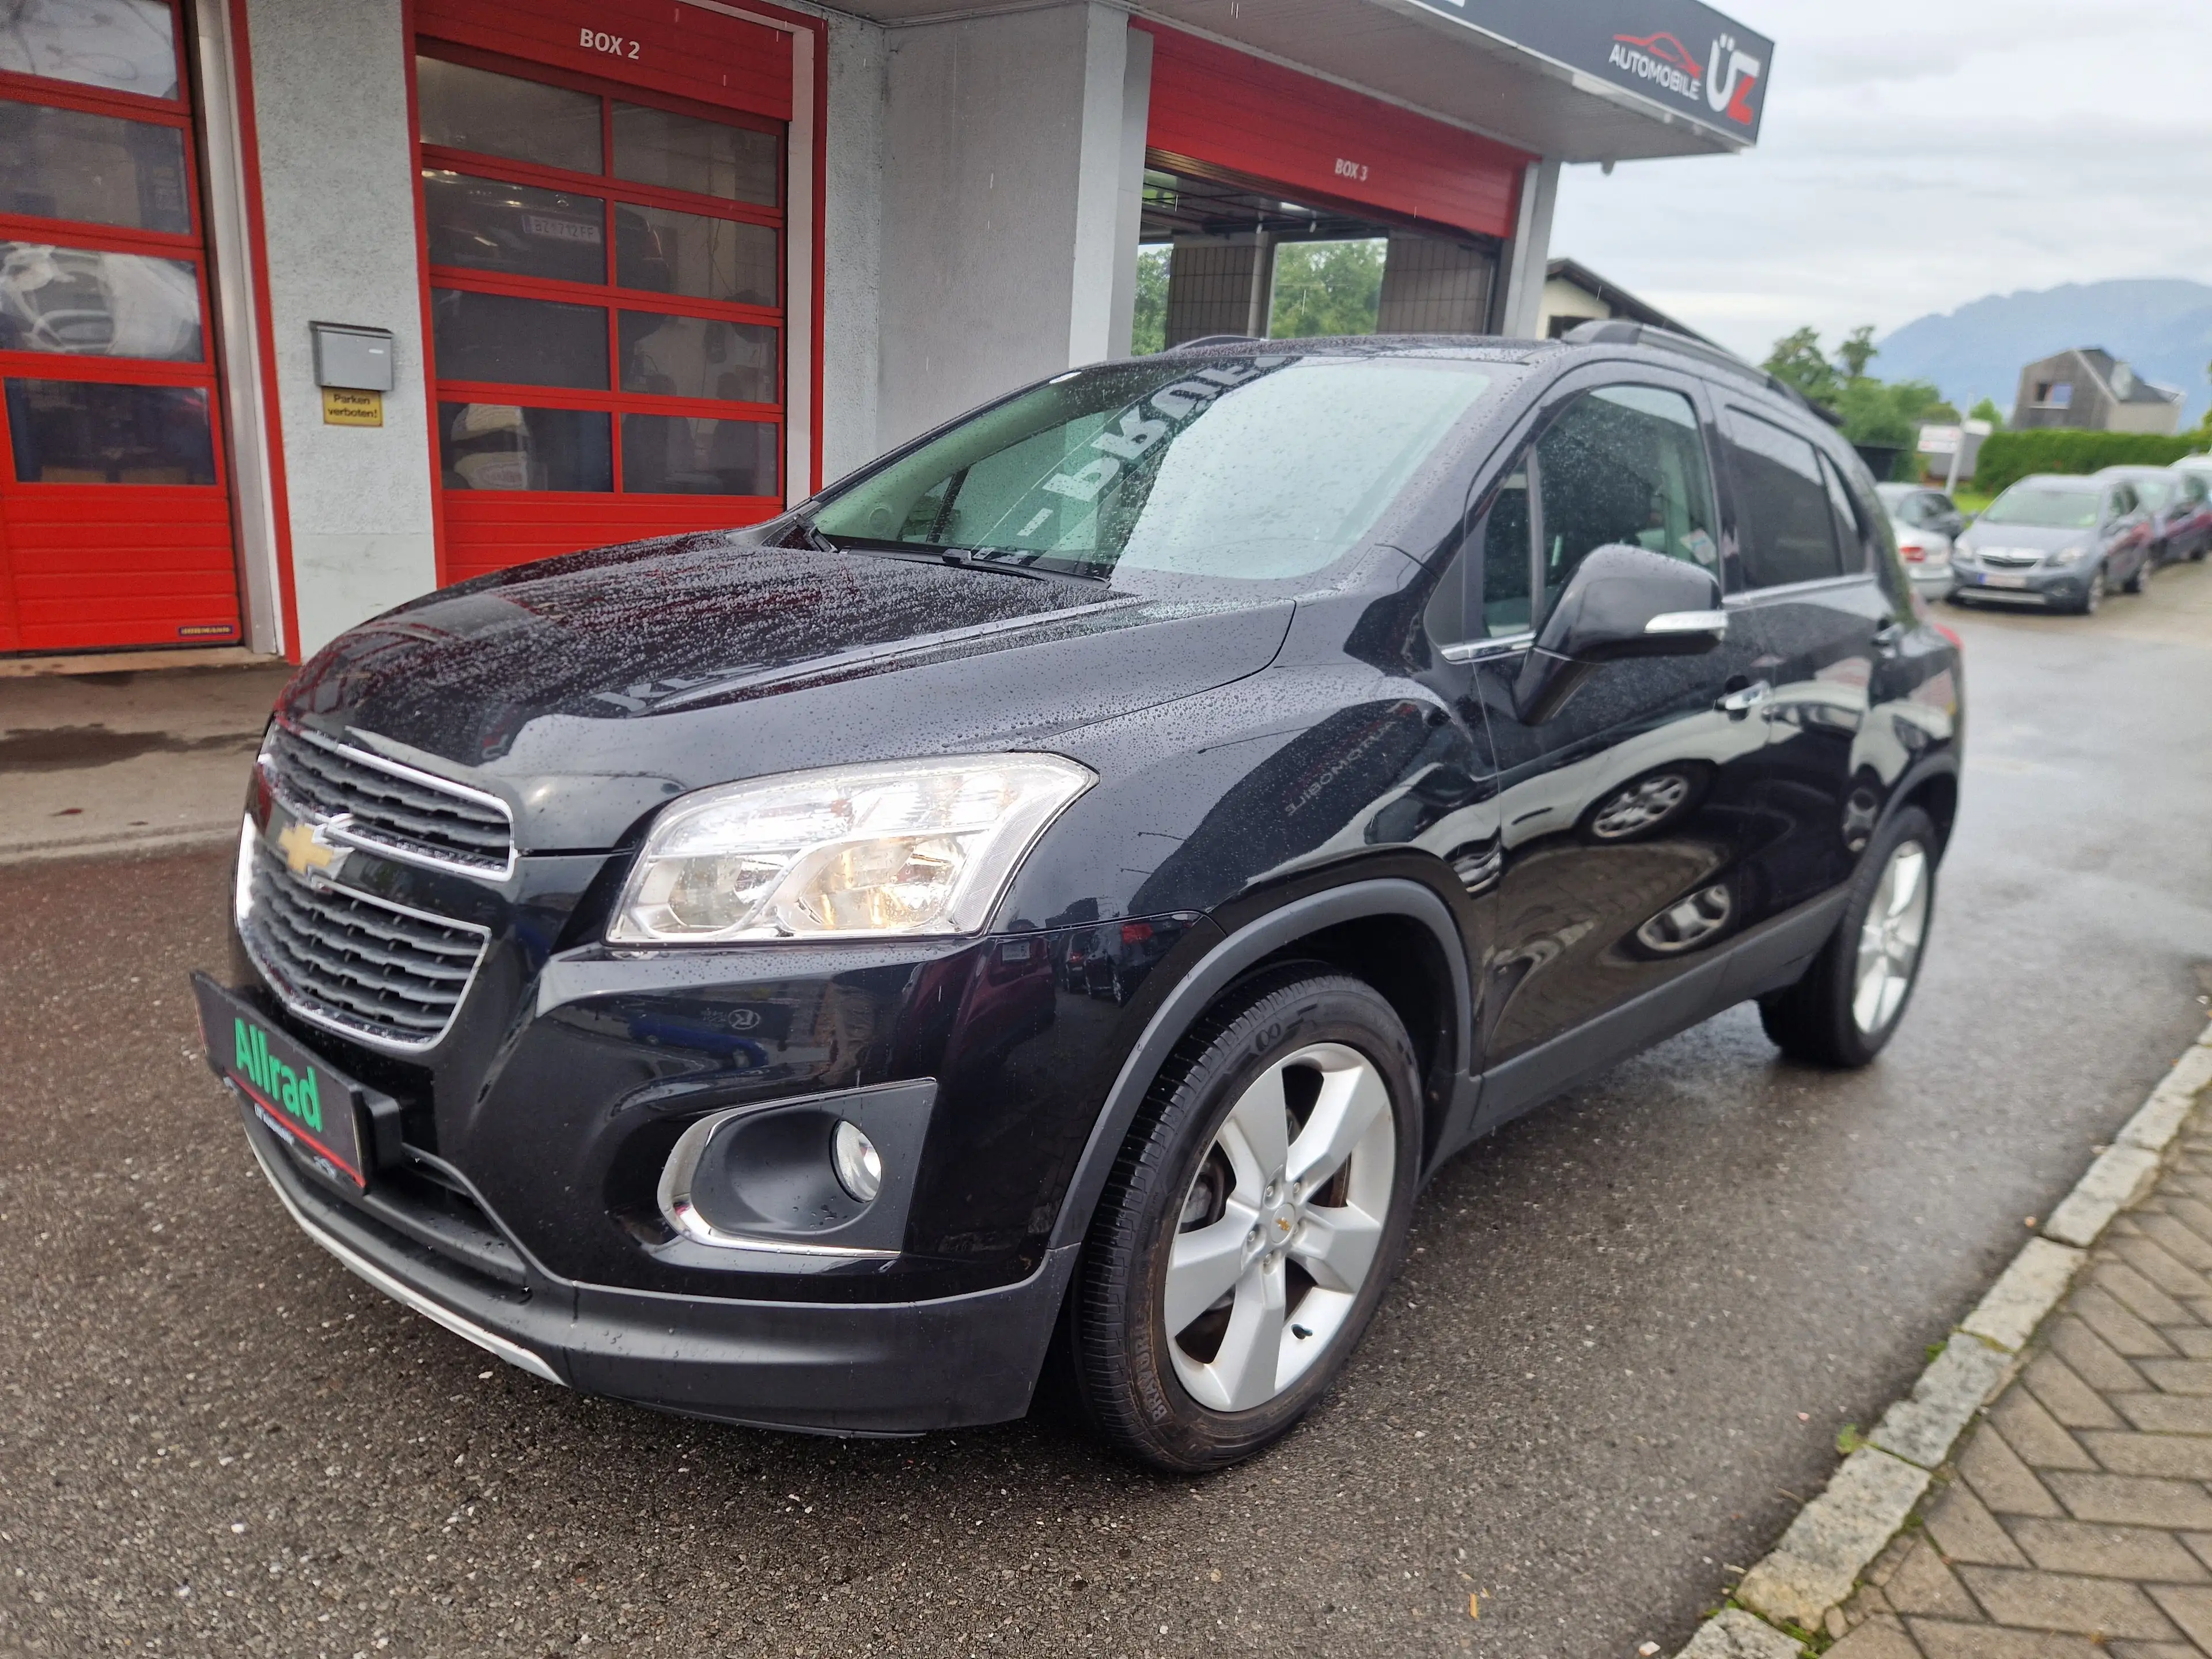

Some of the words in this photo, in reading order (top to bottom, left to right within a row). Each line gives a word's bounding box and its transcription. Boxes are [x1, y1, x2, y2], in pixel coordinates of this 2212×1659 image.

[579, 28, 623, 56] BOX
[627, 41, 640, 60] 2
[1608, 43, 1702, 101] AUTOMOBILE
[1335, 157, 1359, 180] BOX
[1359, 165, 1368, 182] 3
[328, 407, 377, 419] verboten!
[334, 394, 370, 405] Parken
[234, 1017, 323, 1133] Allrad
